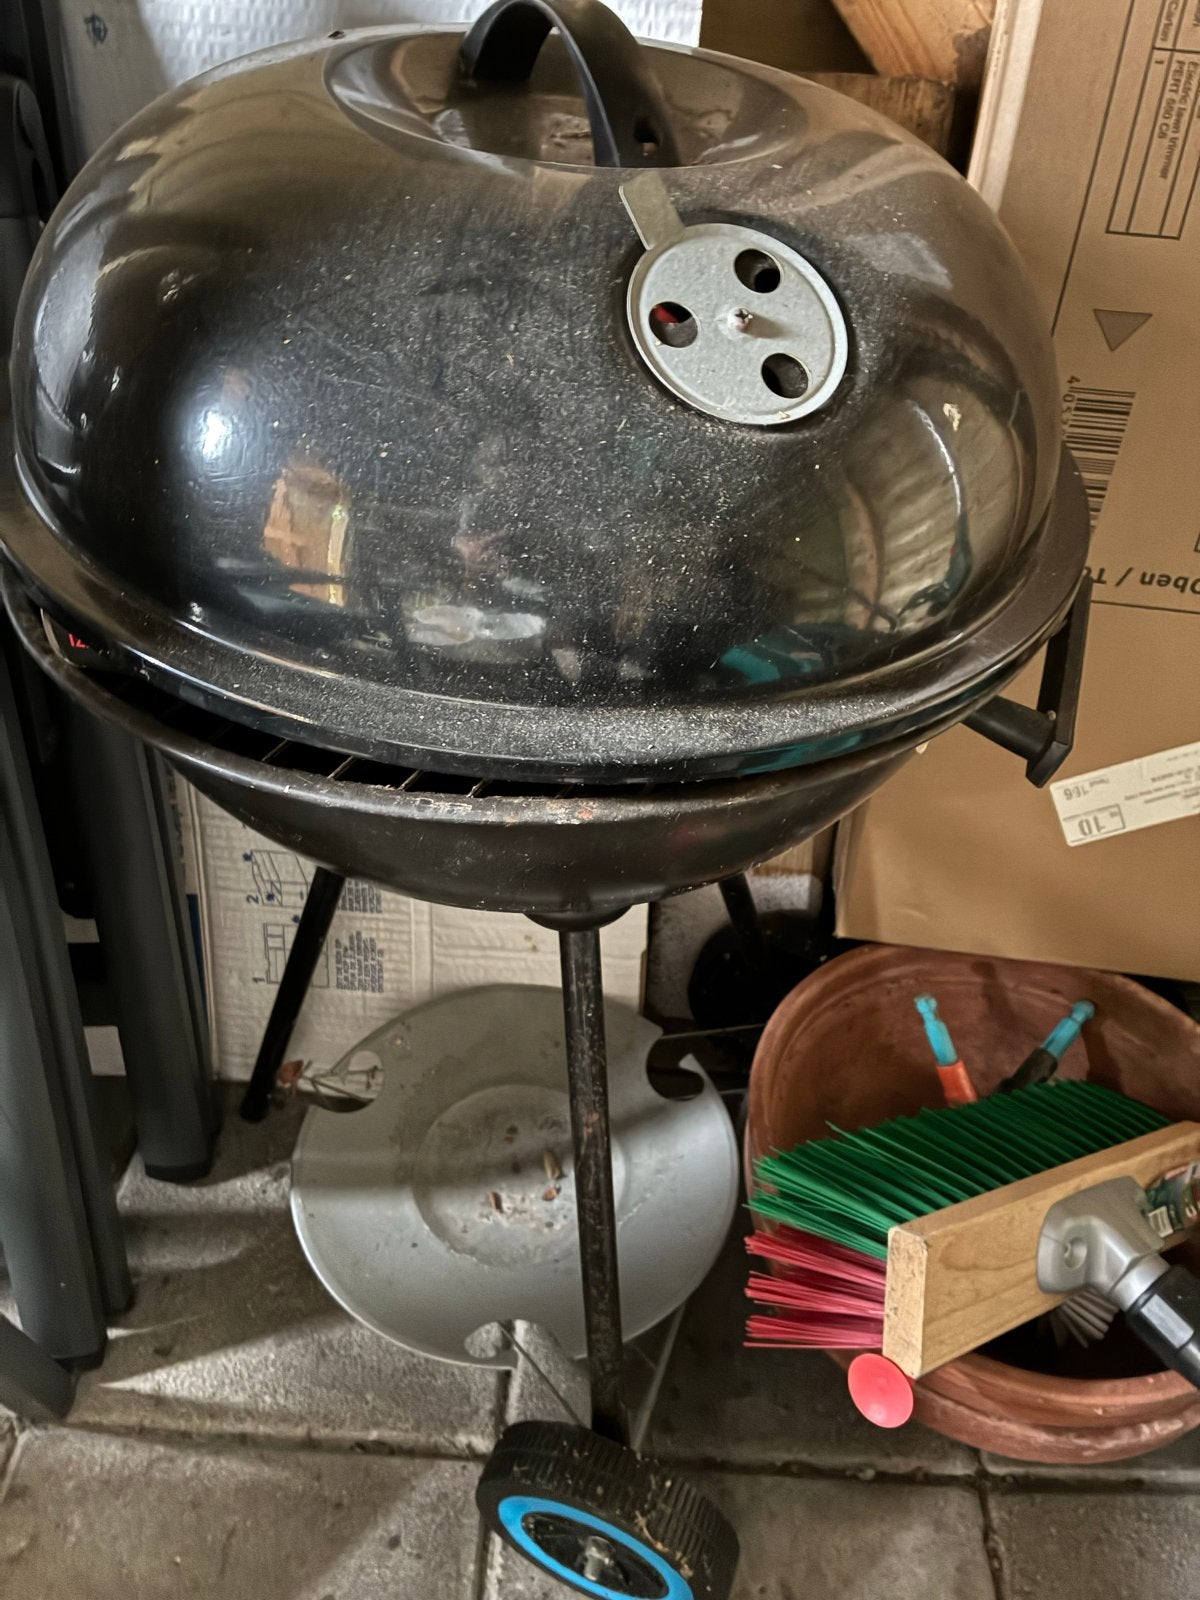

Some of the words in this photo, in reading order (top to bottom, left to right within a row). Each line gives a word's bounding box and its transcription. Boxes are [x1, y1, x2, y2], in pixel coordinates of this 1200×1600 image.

[1159, 136, 1180, 180] trimmer
[246, 894, 260, 905] 2
[252, 976, 266, 984] 1
